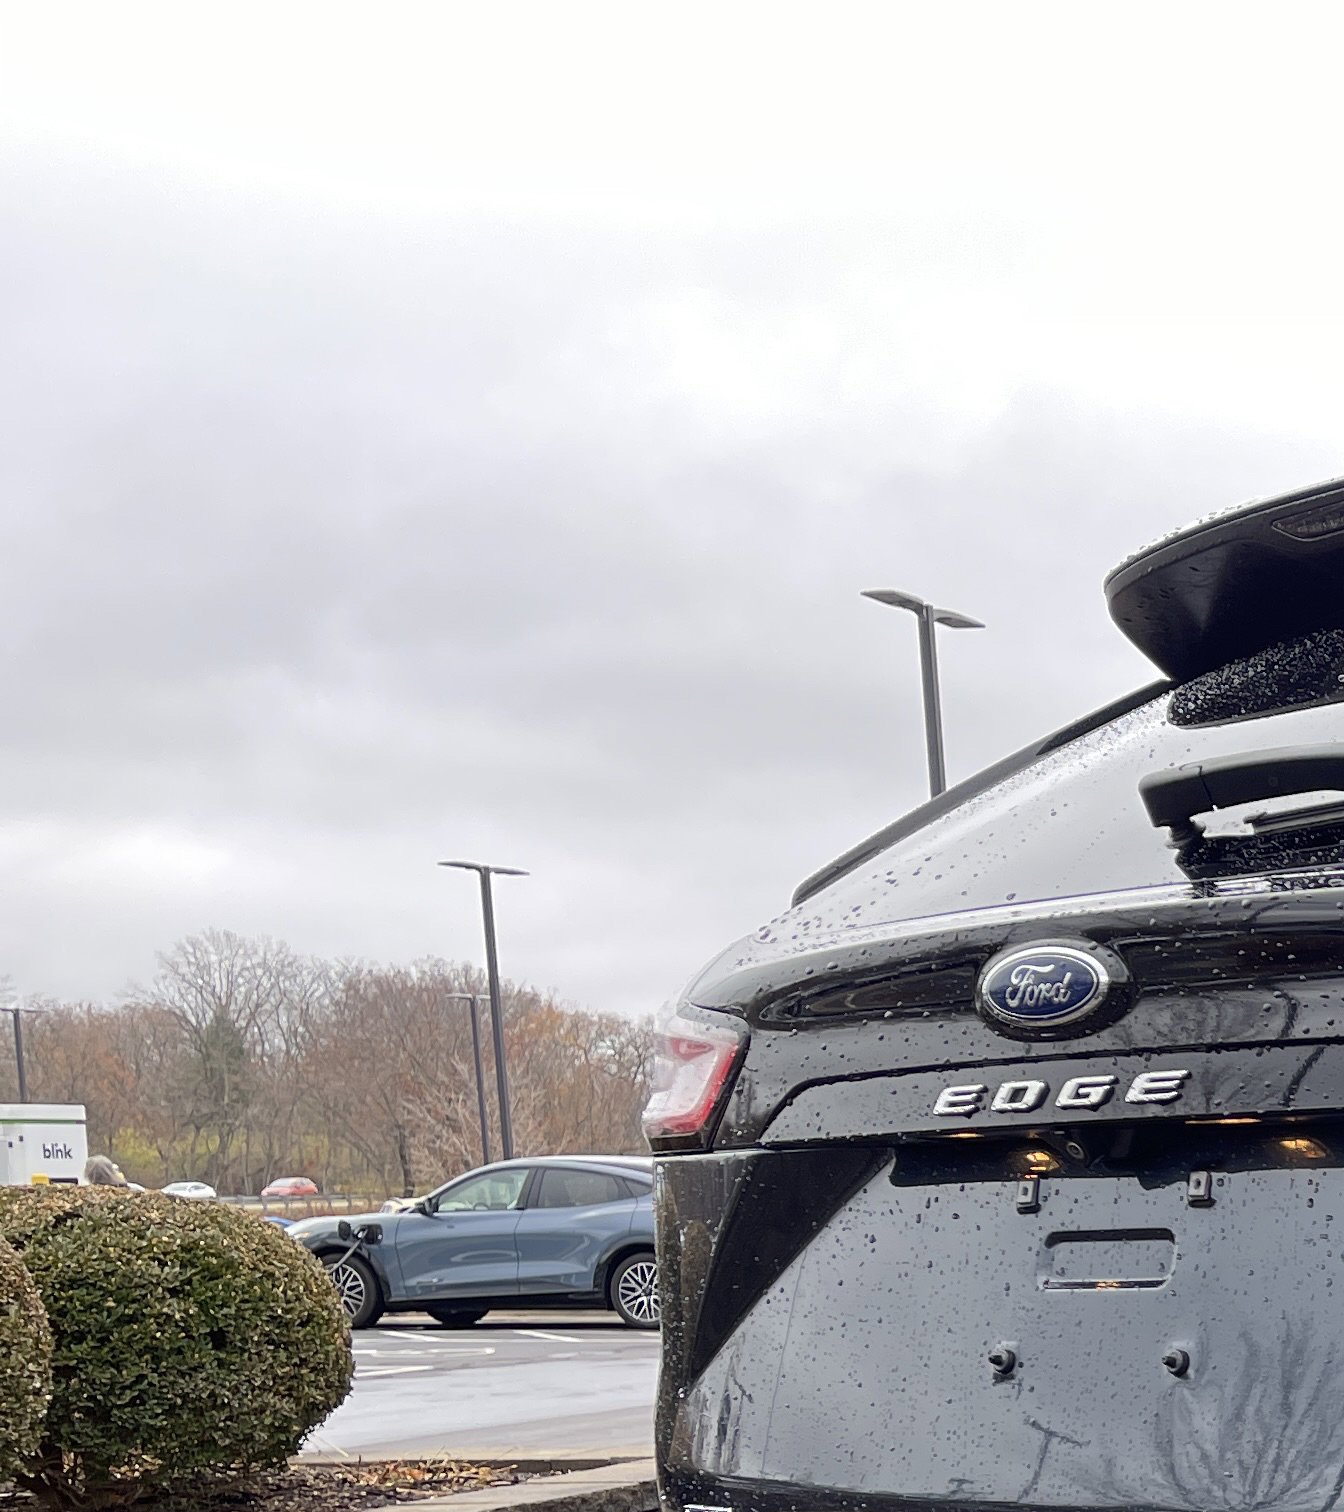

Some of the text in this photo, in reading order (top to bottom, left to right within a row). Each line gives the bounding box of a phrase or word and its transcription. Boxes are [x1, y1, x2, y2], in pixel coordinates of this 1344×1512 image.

[1005, 964, 1072, 1008] Ford
[933, 1069, 1193, 1117] EDGE
[42, 1143, 73, 1159] blink
